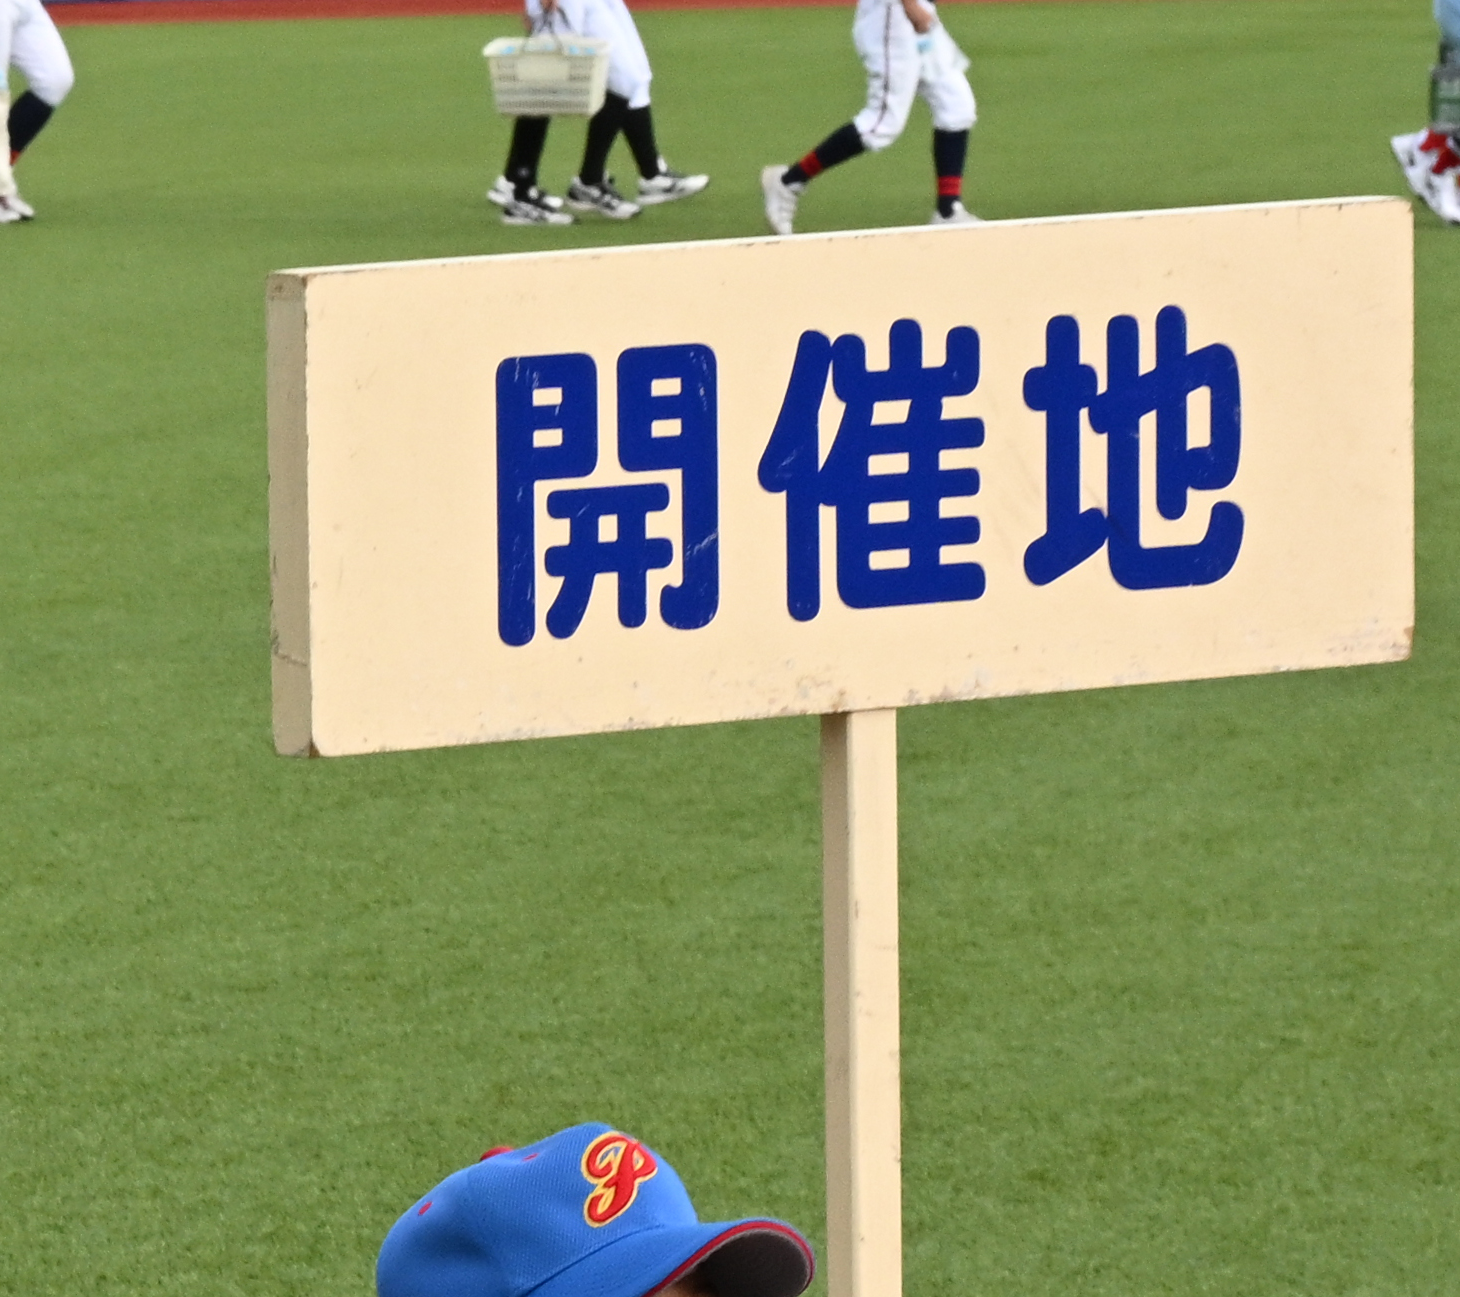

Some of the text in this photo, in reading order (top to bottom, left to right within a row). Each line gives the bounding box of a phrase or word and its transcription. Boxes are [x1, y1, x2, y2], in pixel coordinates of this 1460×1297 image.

[496, 305, 1243, 648] 開催地
[580, 1130, 660, 1228] P
